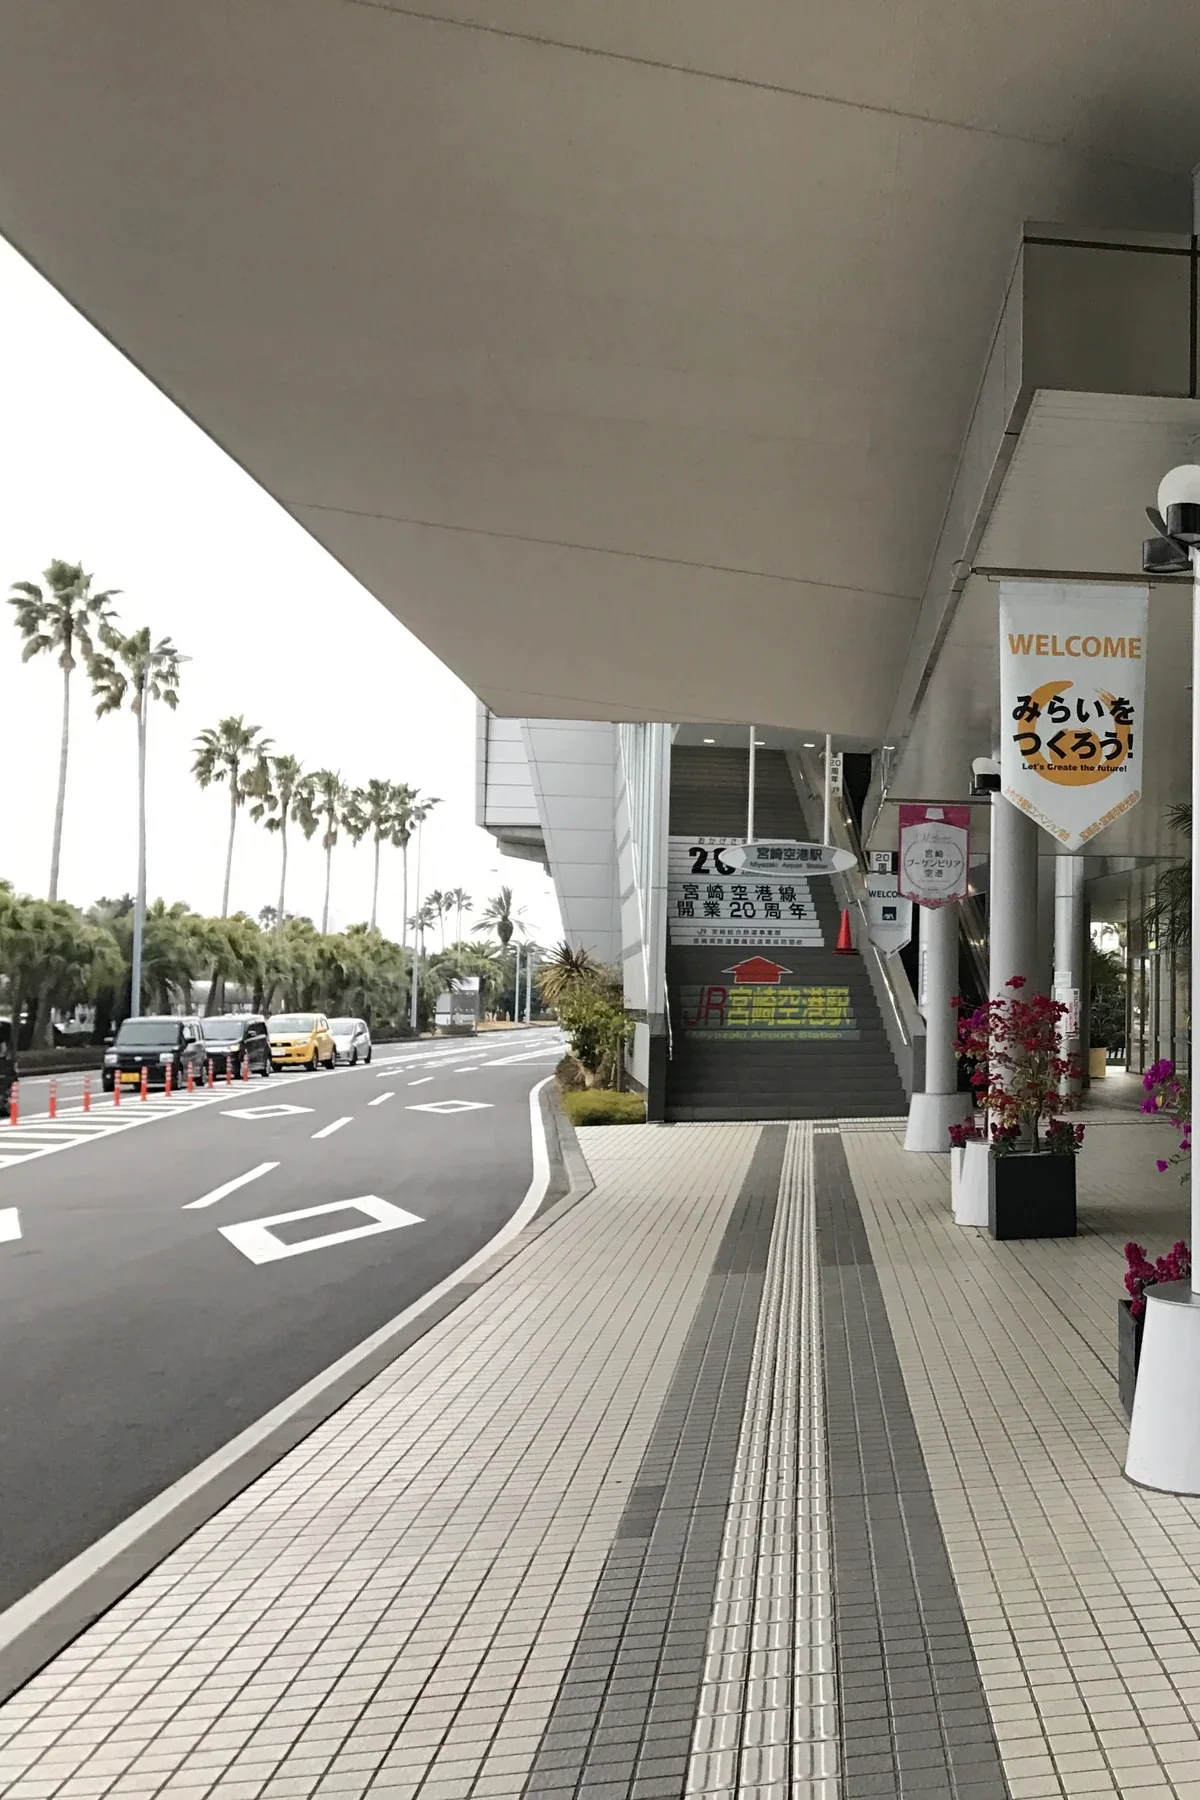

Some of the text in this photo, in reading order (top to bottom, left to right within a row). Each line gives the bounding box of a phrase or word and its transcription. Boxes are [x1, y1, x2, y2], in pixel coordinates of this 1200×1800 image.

[1008, 634, 1142, 659] WELCOME
[1012, 695, 1135, 725] みらいを
[1013, 731, 1134, 760] つくろう!
[1022, 763, 1044, 771] Let's
[1047, 763, 1077, 771] Create
[1080, 764, 1095, 772] the
[756, 847, 823, 862] 宮崎空港駅
[925, 849, 944, 858] 宮崎
[907, 859, 961, 868] ブーゲンビリア
[924, 869, 943, 878] 空港
[682, 884, 797, 902] 宮崎空港線
[677, 902, 807, 920] 開業20周年
[692, 1030, 843, 1040] Miyazaki Airport Station
